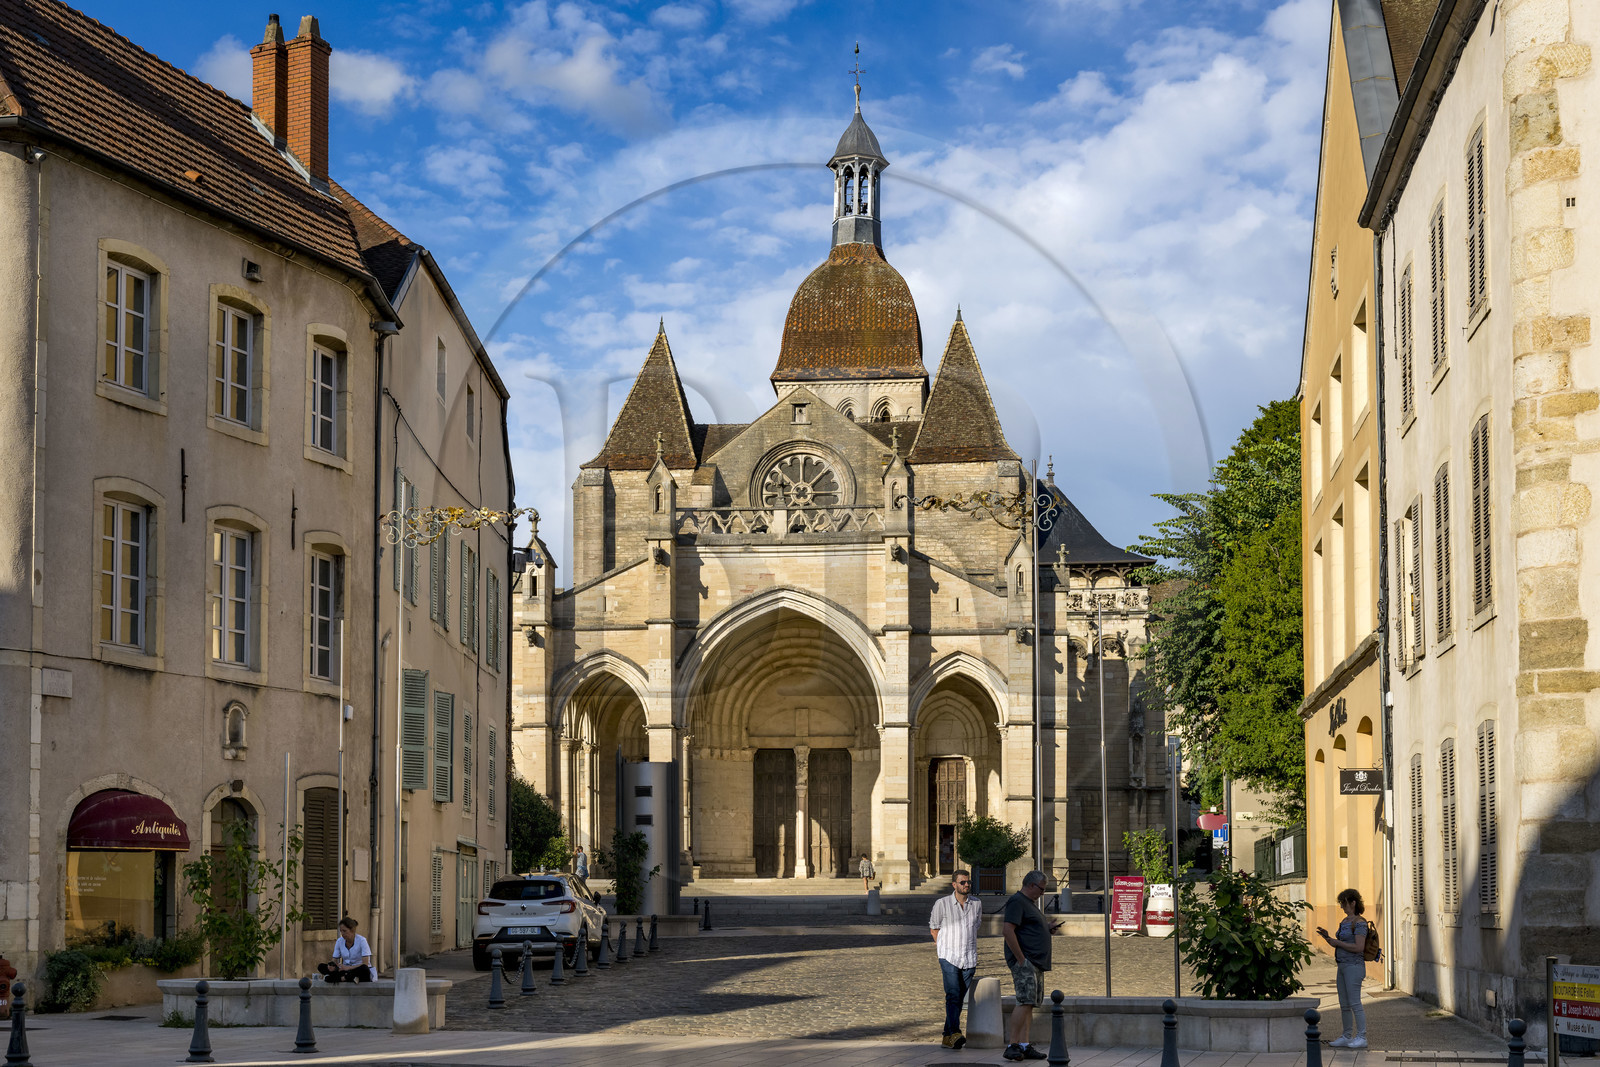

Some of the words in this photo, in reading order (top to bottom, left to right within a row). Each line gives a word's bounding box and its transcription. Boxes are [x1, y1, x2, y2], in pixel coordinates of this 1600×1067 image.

[1554, 985, 1583, 997] MOUTARDERIE
[1568, 1004, 1582, 1017] Joseph
[1566, 1021, 1581, 1033] Musée
[1586, 1024, 1595, 1034] Vin
